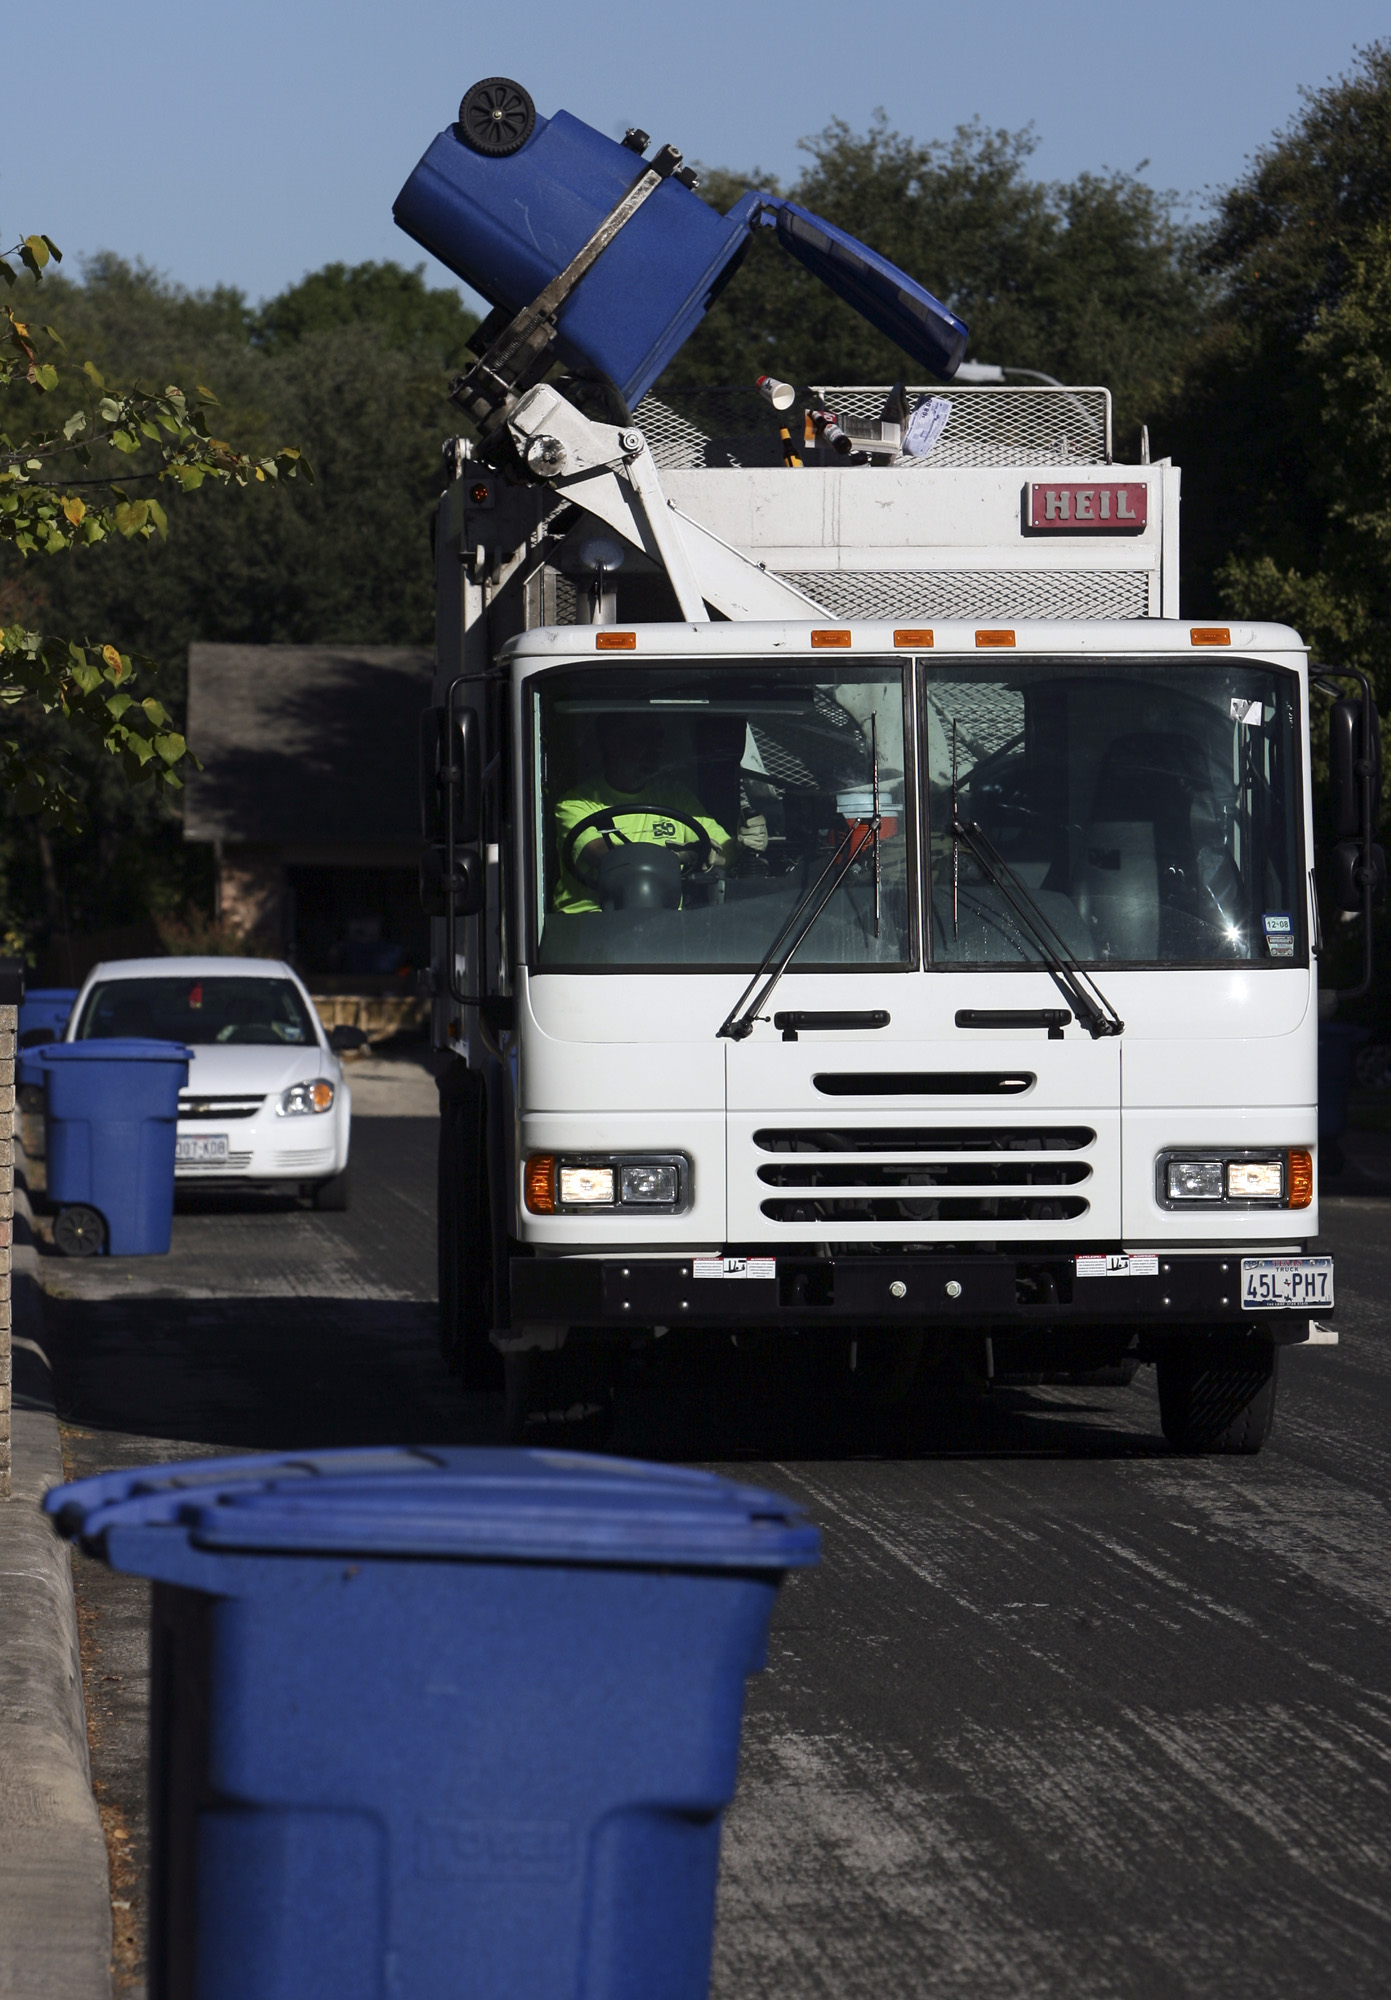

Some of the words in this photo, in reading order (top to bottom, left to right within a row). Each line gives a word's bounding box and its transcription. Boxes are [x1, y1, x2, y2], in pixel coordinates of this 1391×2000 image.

[1044, 490, 1136, 520] HEIL
[1247, 1274, 1282, 1298] 45L
[1292, 1273, 1328, 1297] PH7
